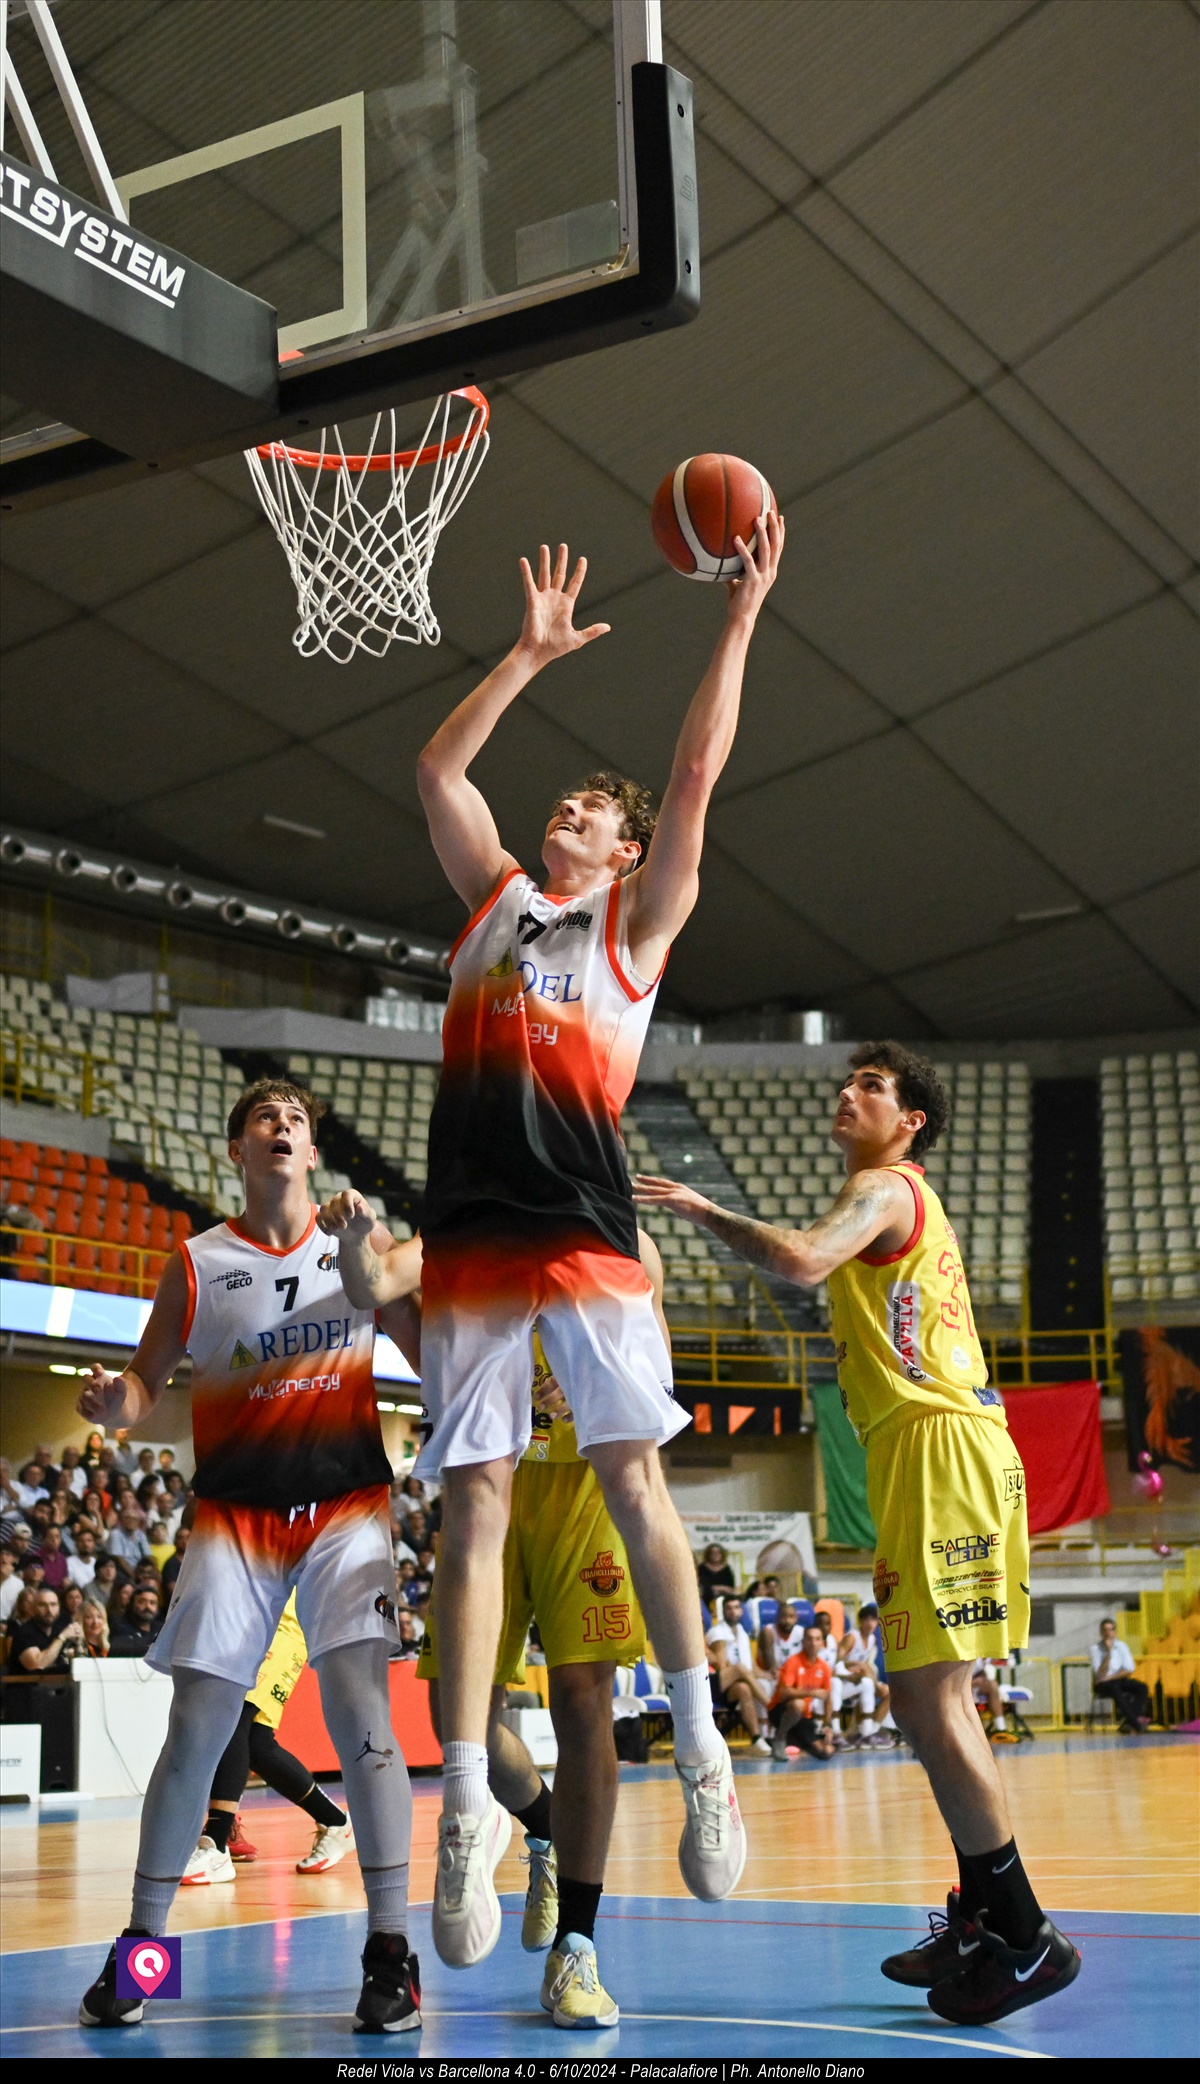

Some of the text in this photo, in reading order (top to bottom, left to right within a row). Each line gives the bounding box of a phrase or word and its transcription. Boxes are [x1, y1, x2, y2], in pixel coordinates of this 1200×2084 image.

[0, 162, 186, 299] TSYSTEM
[516, 961, 583, 1003] DEL
[226, 1277, 252, 1291] GECO
[275, 1276, 299, 1312] 7
[257, 1318, 353, 1362] REDEL
[931, 1533, 1000, 1554] SACCNE
[582, 1604, 631, 1642] 15
[936, 1599, 1007, 1628] Sottile
